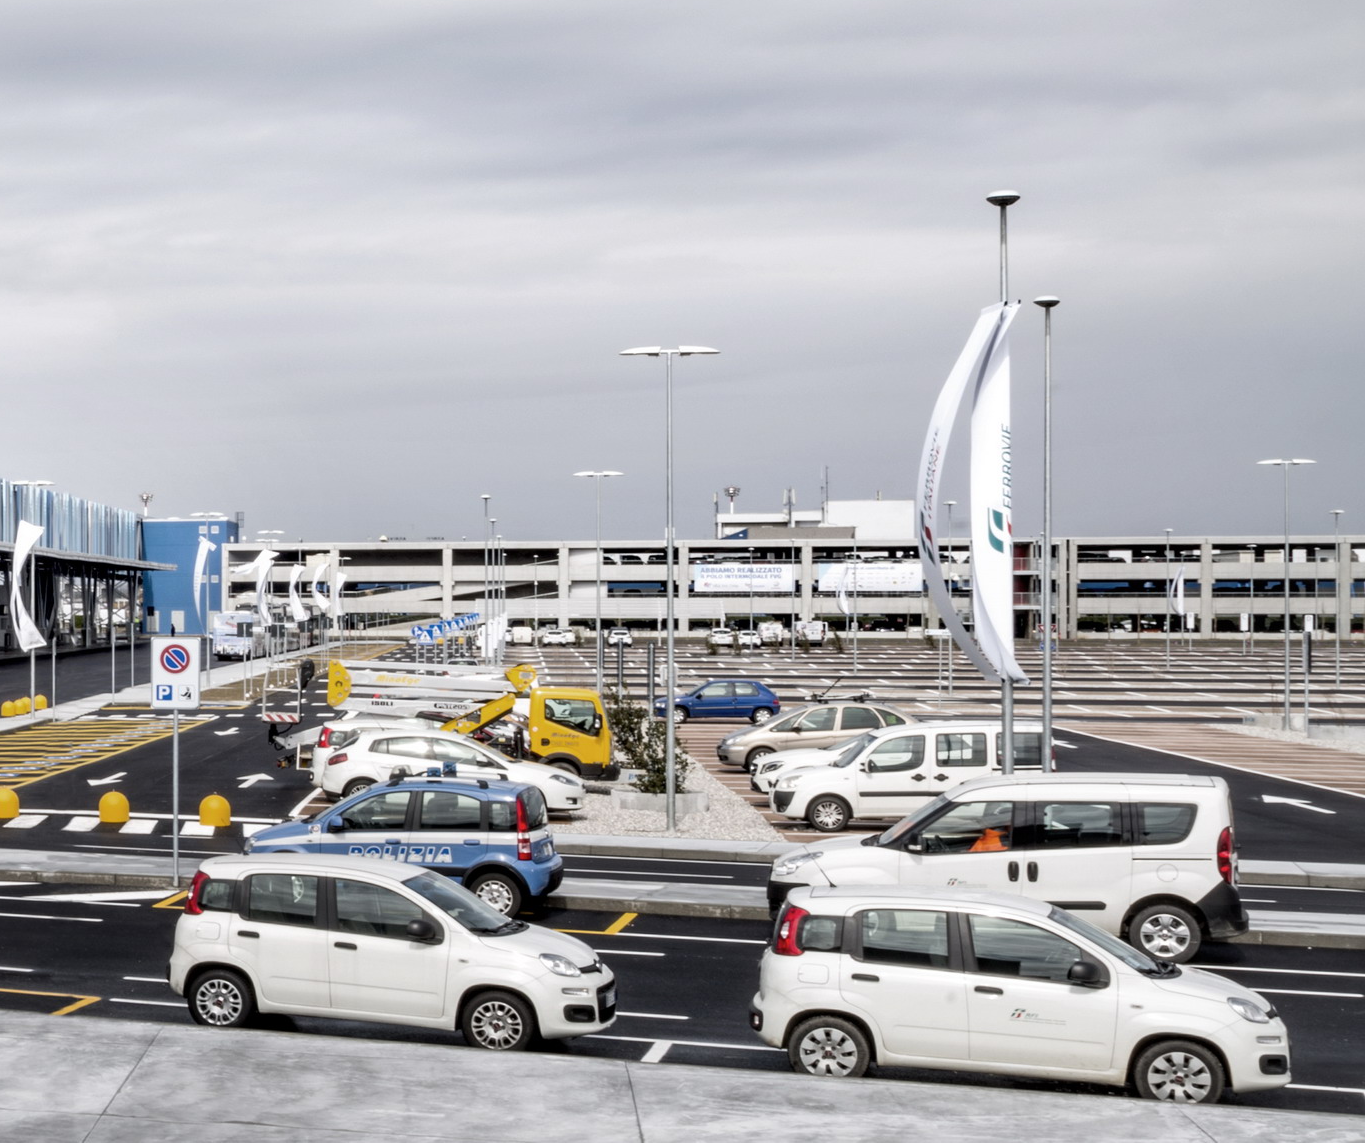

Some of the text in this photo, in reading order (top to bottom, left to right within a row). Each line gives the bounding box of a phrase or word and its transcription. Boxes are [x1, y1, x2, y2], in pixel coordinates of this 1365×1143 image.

[1001, 423, 1012, 510] FERROVIE
[158, 686, 170, 700] P
[348, 845, 453, 864] POLIZIA
